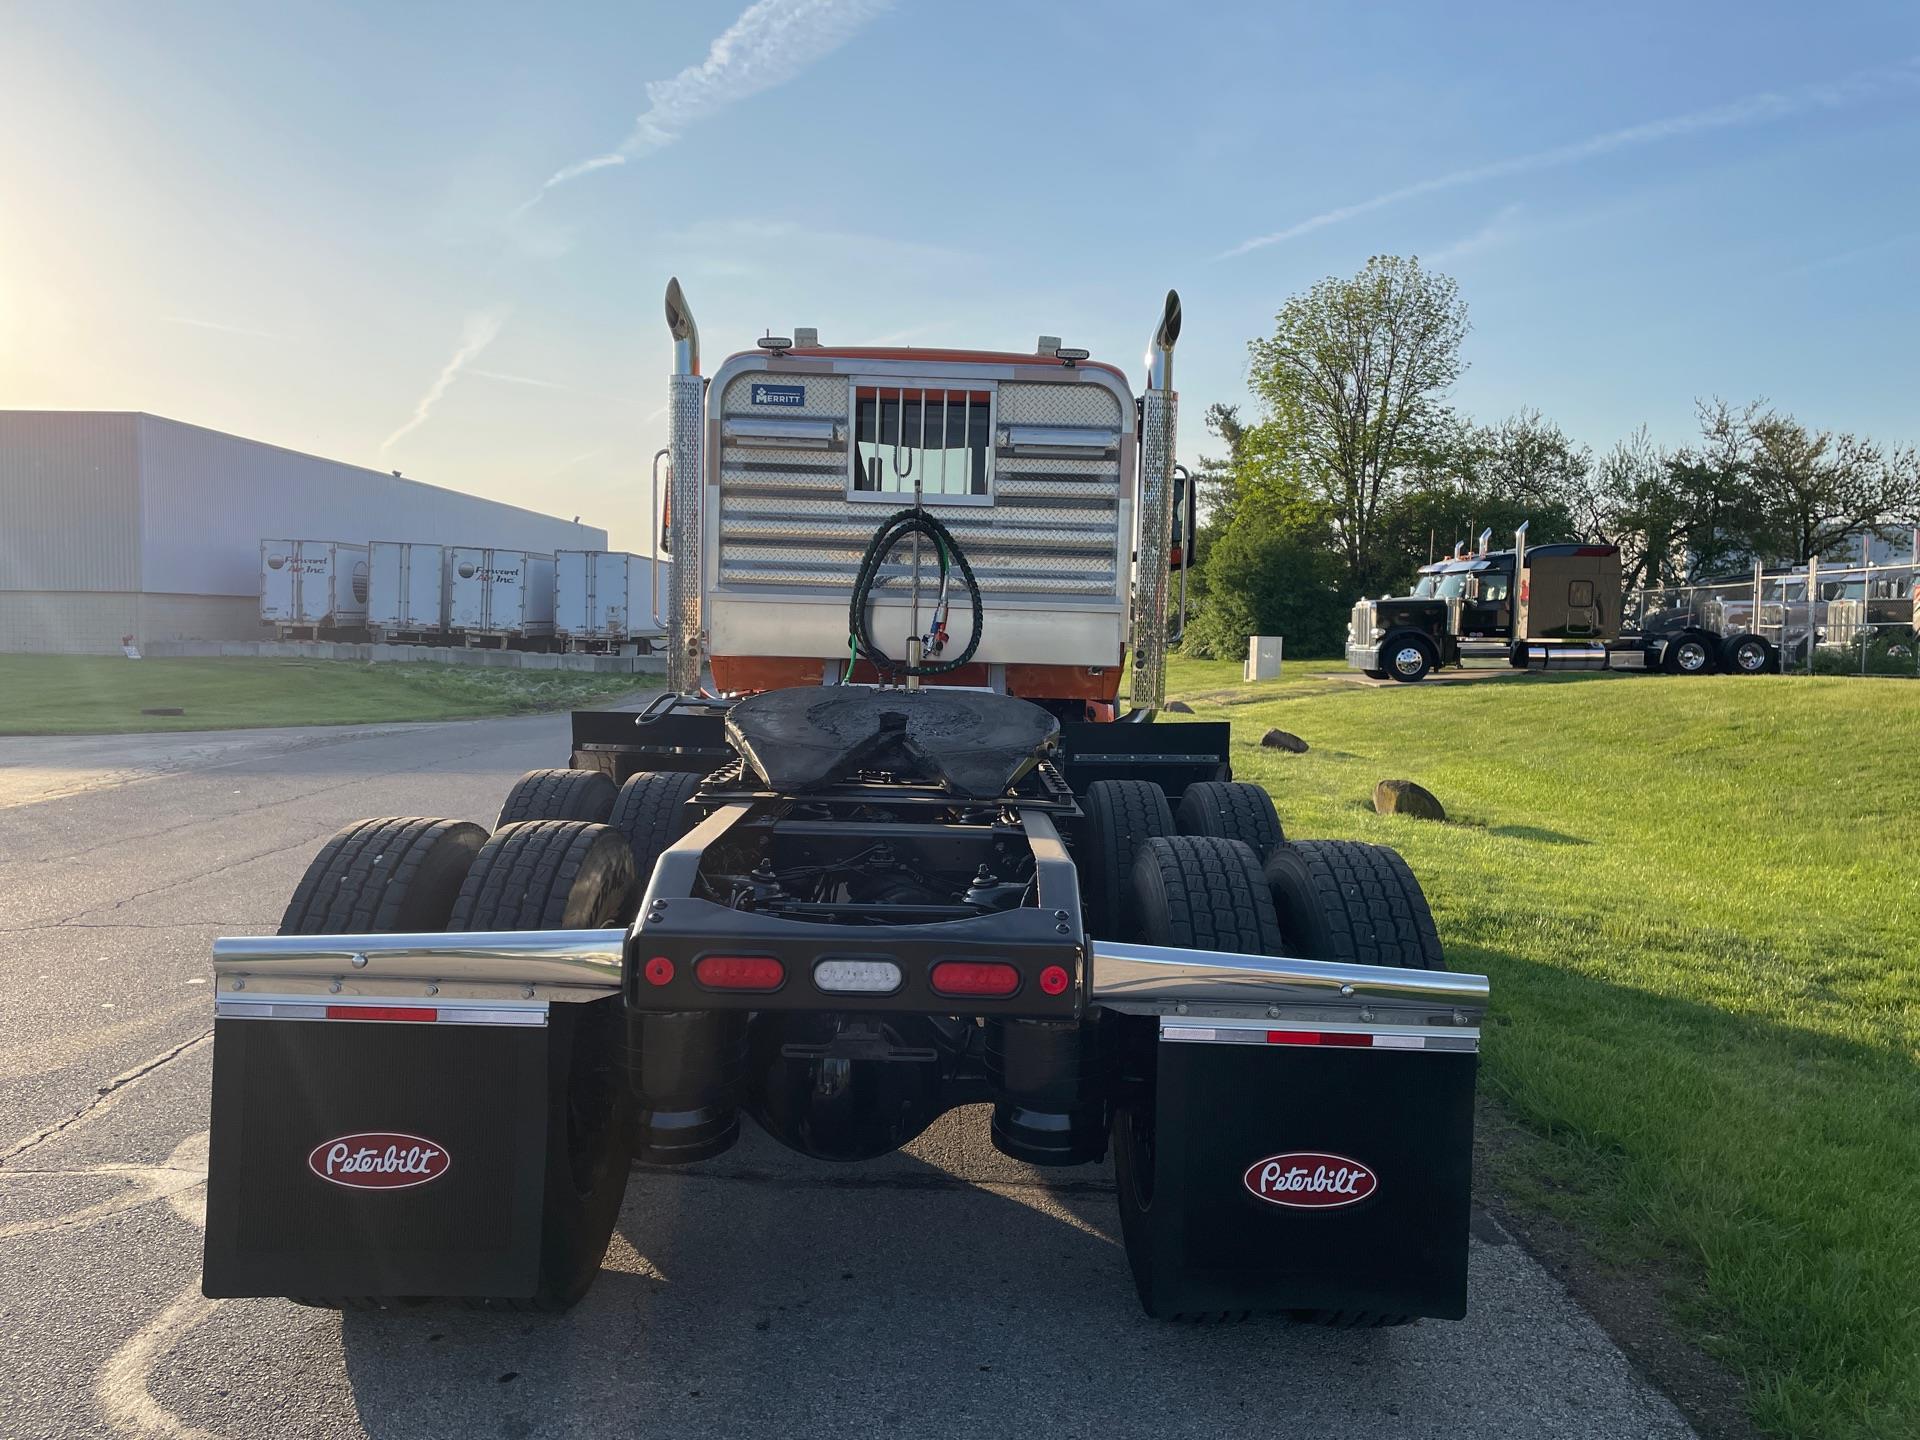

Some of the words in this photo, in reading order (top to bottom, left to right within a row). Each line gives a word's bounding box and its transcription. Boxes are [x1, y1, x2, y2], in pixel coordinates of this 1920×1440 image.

[756, 394, 801, 404] MERRITT
[326, 1143, 439, 1175] Peterbilt
[1260, 1162, 1367, 1194] Peterbilt
